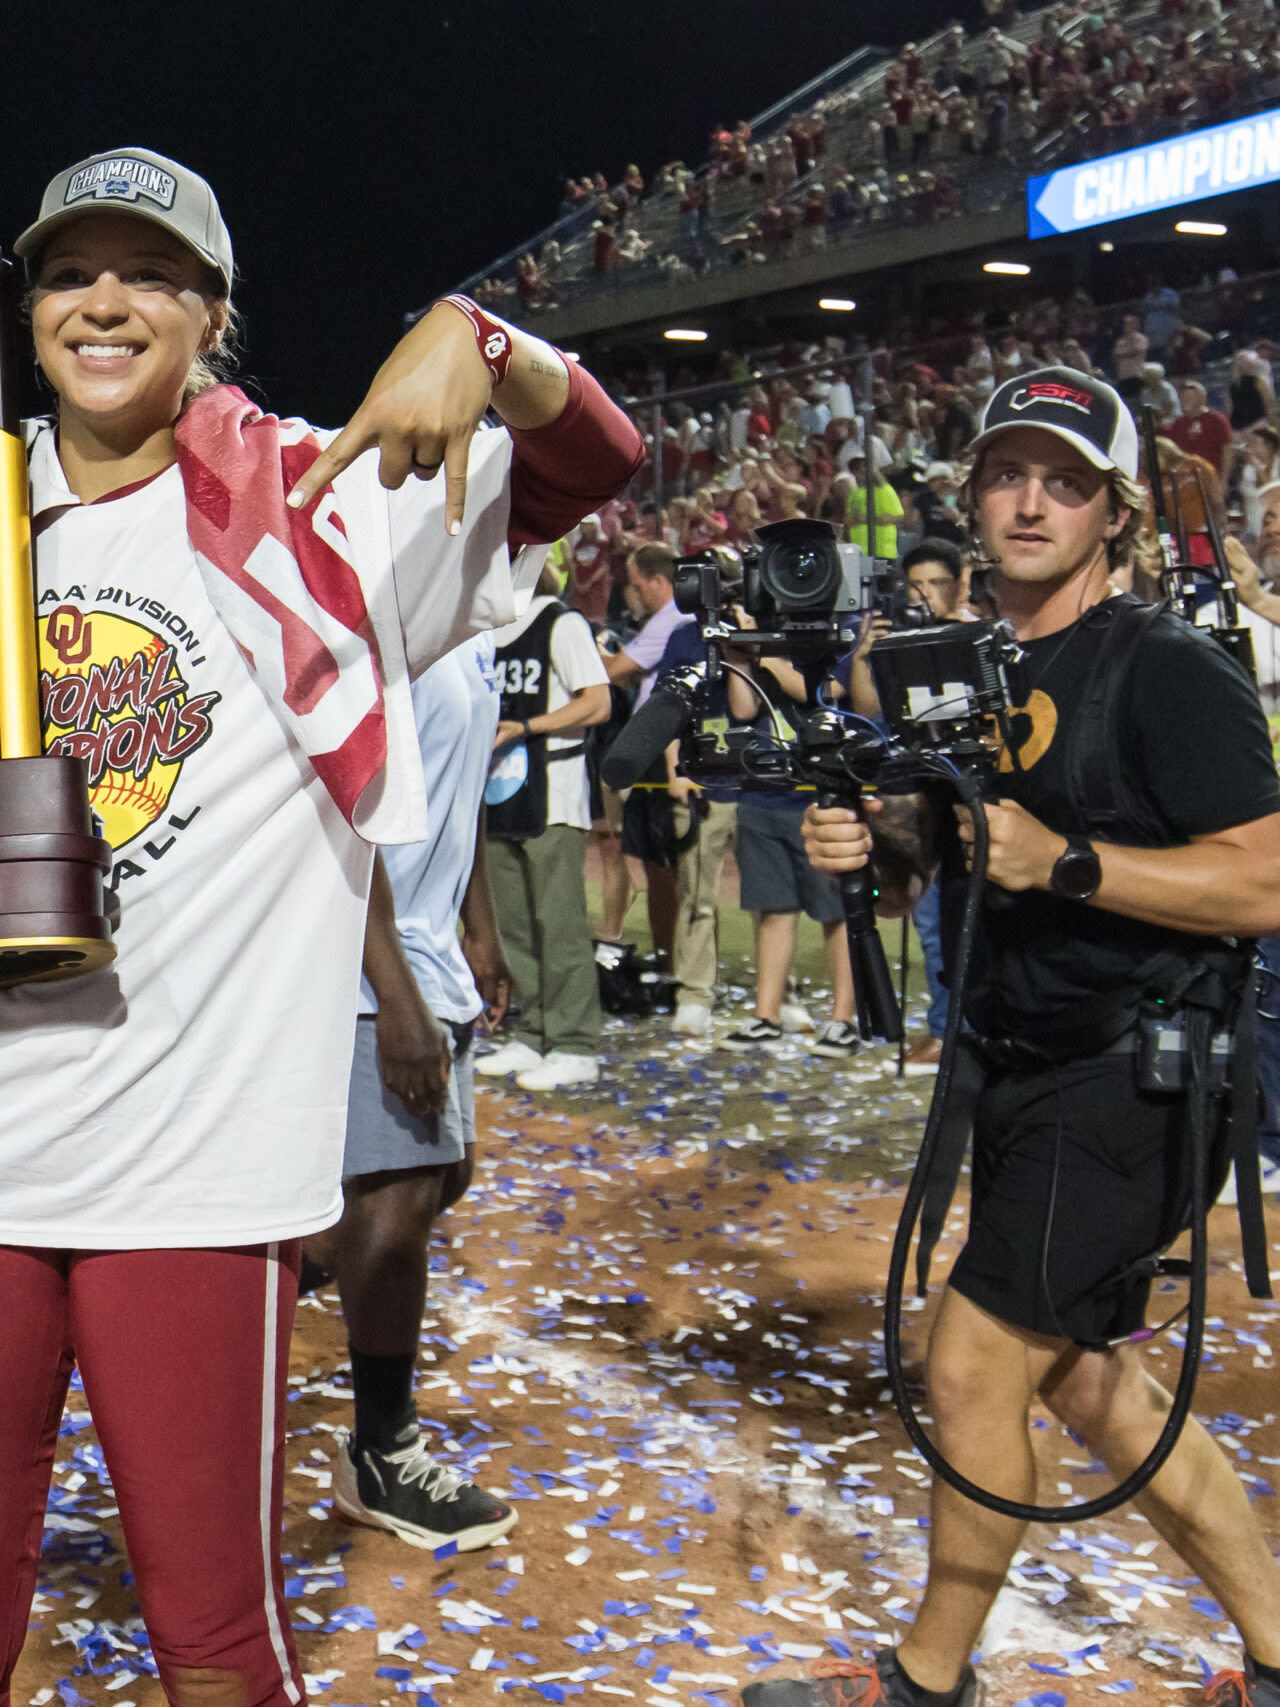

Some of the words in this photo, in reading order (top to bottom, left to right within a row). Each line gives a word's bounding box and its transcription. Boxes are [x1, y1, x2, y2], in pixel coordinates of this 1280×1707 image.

[71, 160, 171, 198] CHAMPIONS
[38, 585, 86, 604] AA
[95, 586, 200, 652] DIVISION
[191, 655, 206, 667] I
[46, 604, 92, 665] OU
[41, 645, 186, 730] IONAL
[494, 658, 542, 695] 432
